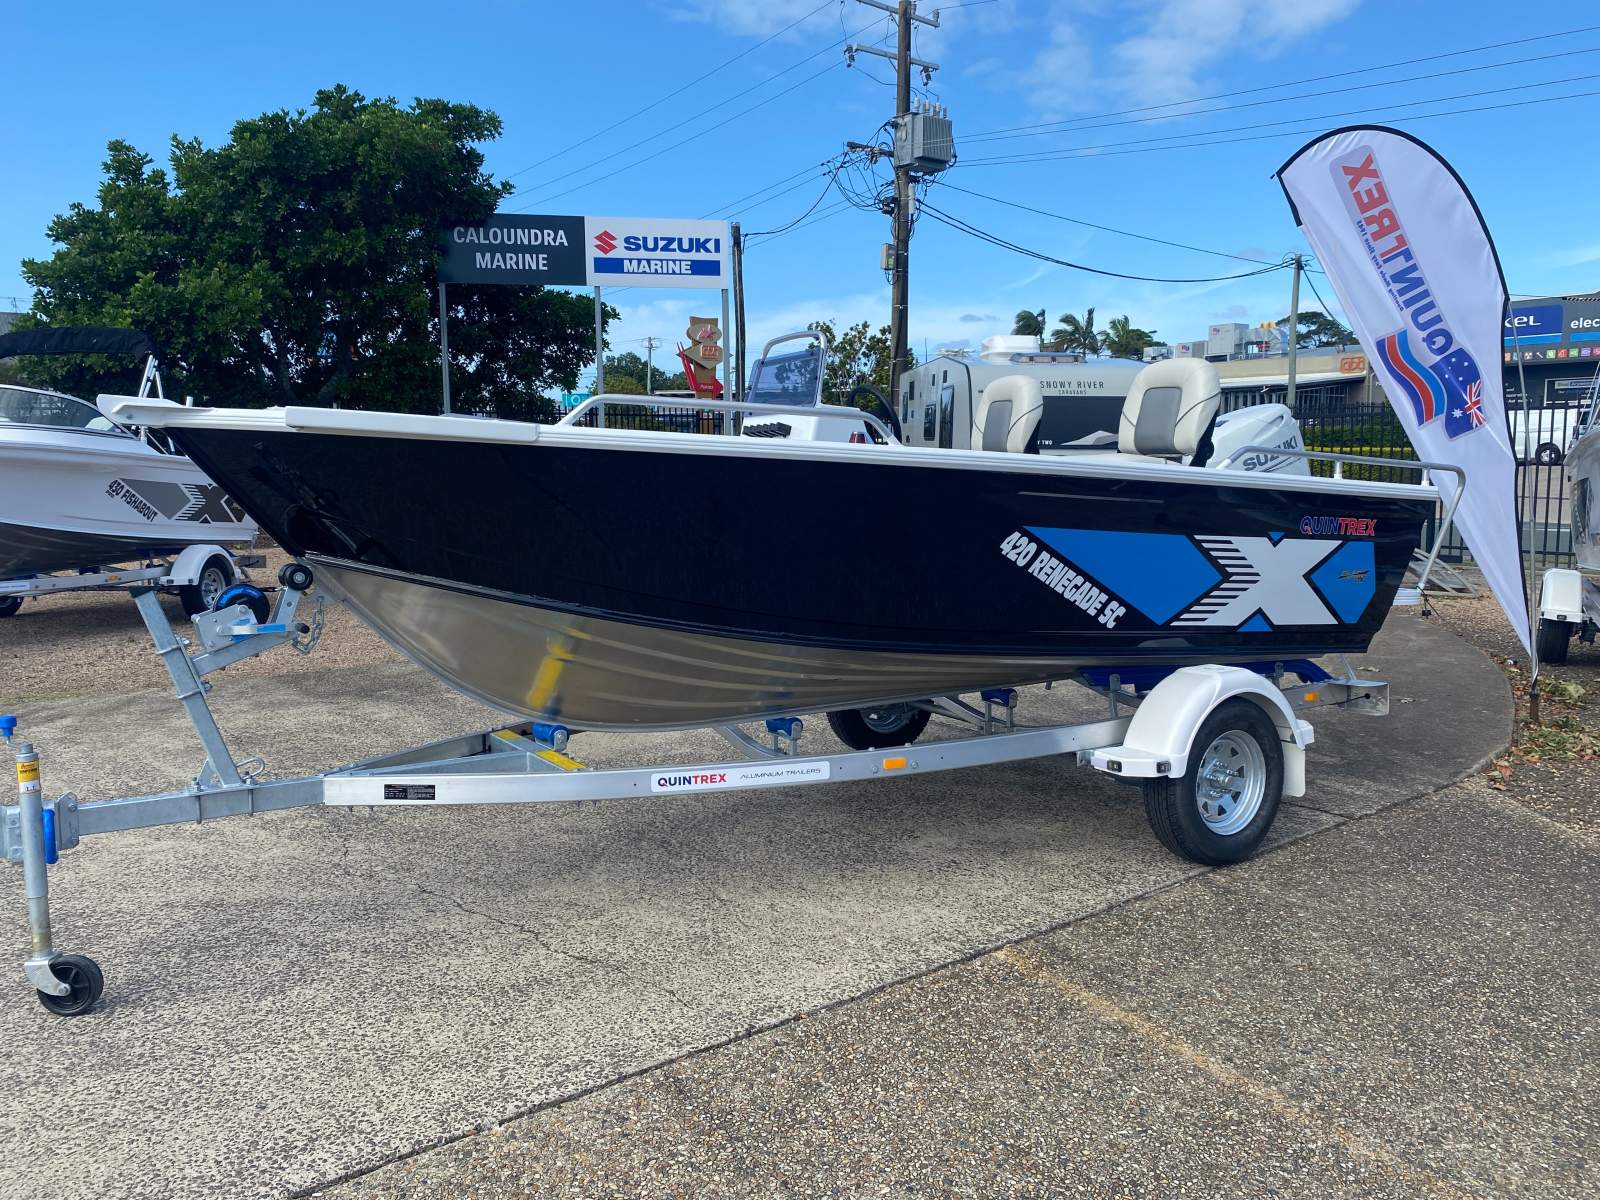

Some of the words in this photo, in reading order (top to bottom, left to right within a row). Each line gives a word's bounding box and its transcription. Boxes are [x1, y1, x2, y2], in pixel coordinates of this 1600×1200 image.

[453, 227, 568, 246] CALOUNDRA
[623, 236, 720, 253] SUZUKI
[475, 252, 548, 270] MARINE
[623, 259, 692, 274] MARINE
[1040, 380, 1072, 389] SNOWY
[1077, 380, 1104, 389] RIVER
[108, 479, 125, 497] 430
[120, 489, 158, 523] FISHABOUT
[1300, 516, 1377, 537] QUINTREX
[1000, 531, 1038, 567] 420
[1028, 550, 1109, 617] RENEGADE
[1098, 600, 1126, 629] SC
[657, 773, 727, 788] QUINTREX
[740, 769, 784, 780] ALUMINIUM
[785, 768, 822, 776] TRAILERS
